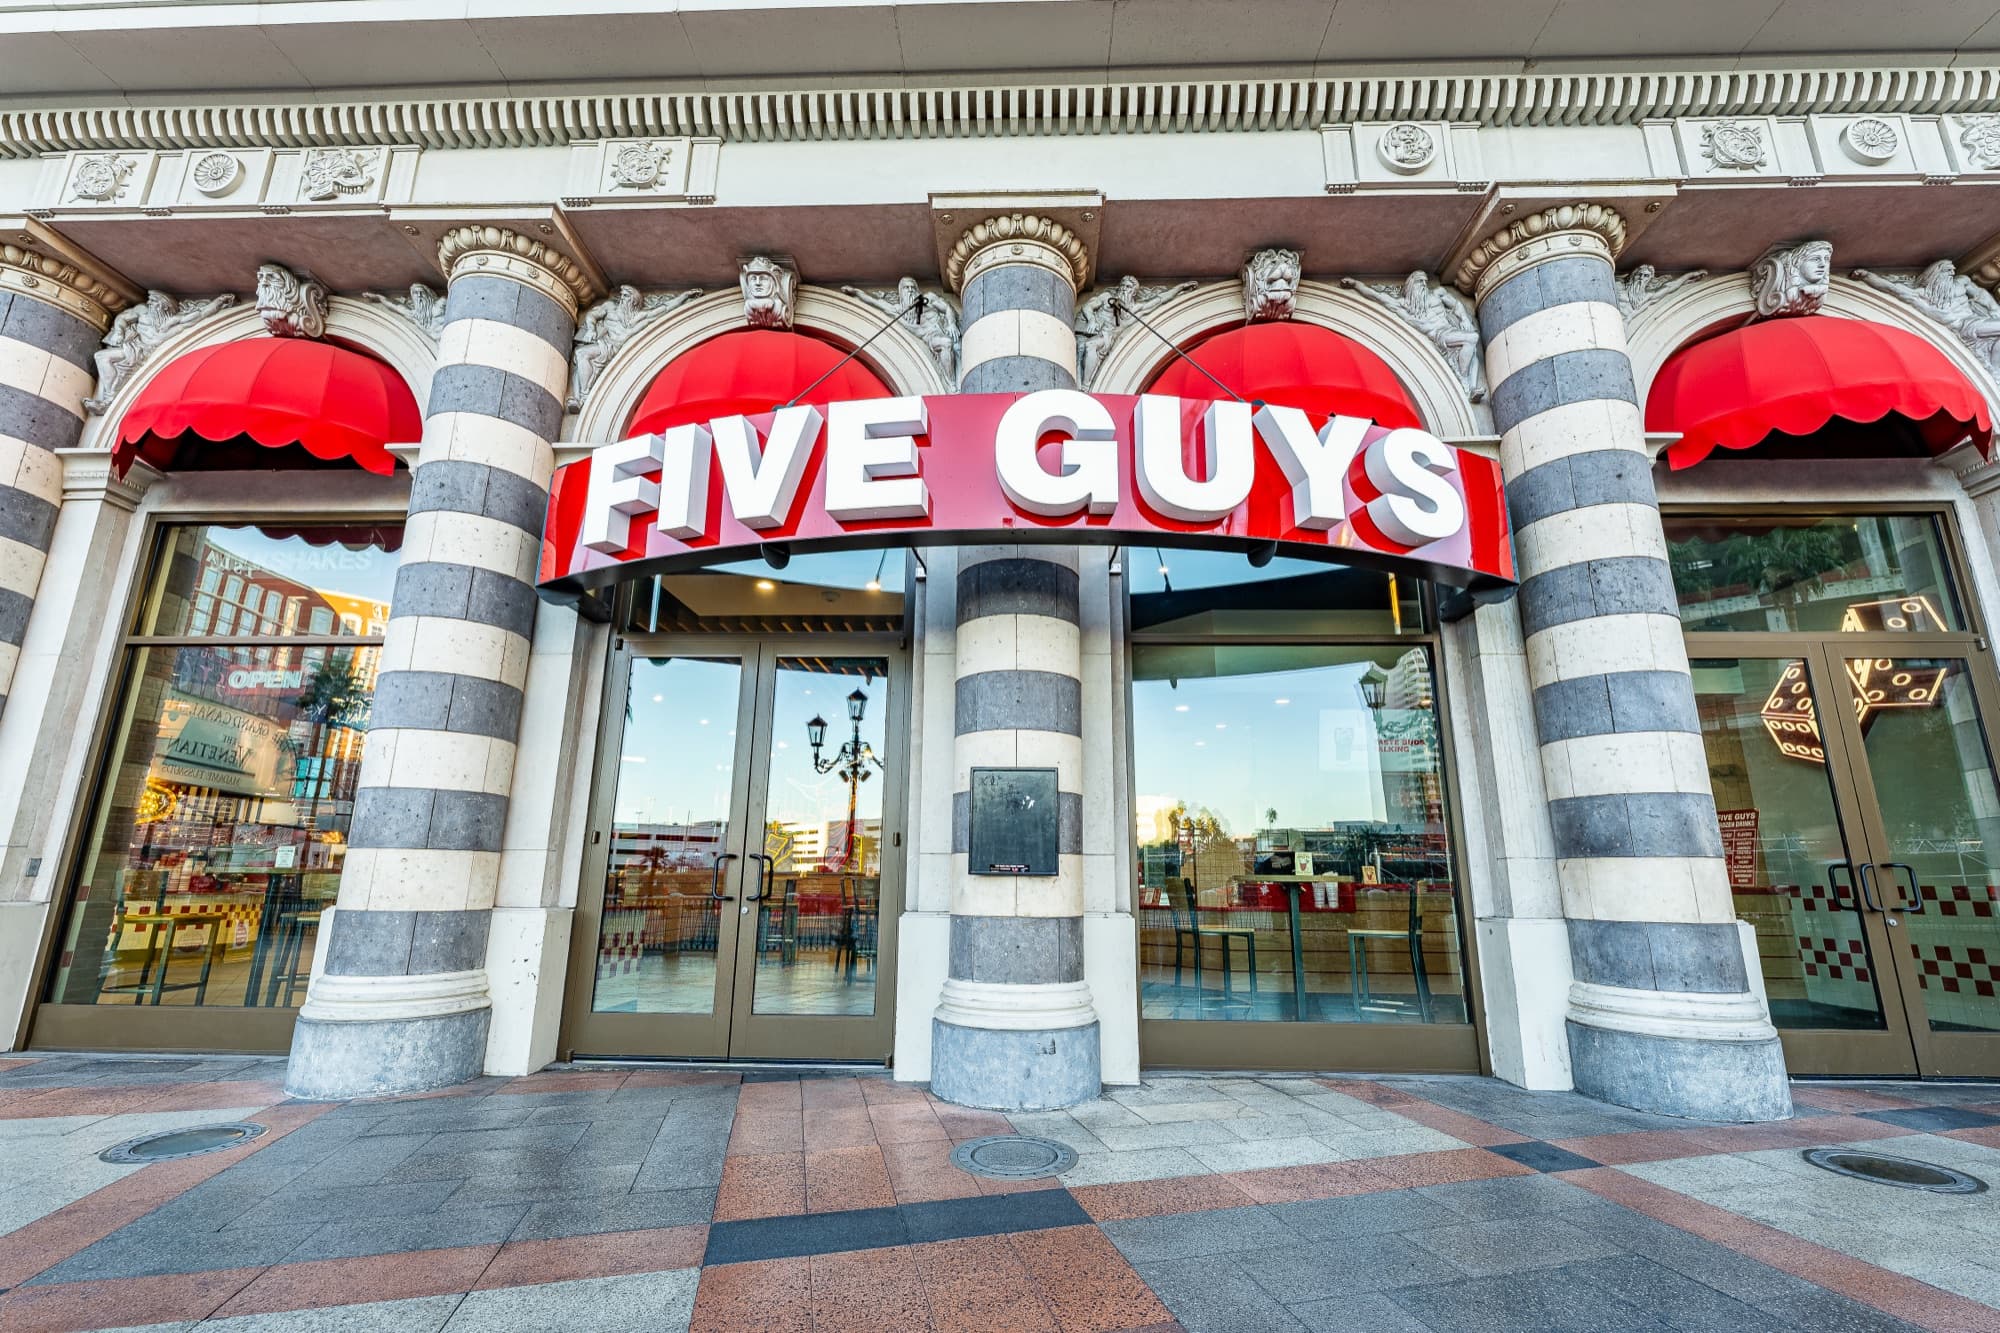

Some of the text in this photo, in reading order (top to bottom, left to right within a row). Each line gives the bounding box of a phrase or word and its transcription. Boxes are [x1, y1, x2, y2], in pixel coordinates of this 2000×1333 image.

[582, 389, 1464, 555] FIVE GUYS
[228, 670, 303, 689] OPEN
[1734, 812, 1756, 820] GUYS
[1735, 820, 1755, 828] DRINKS
